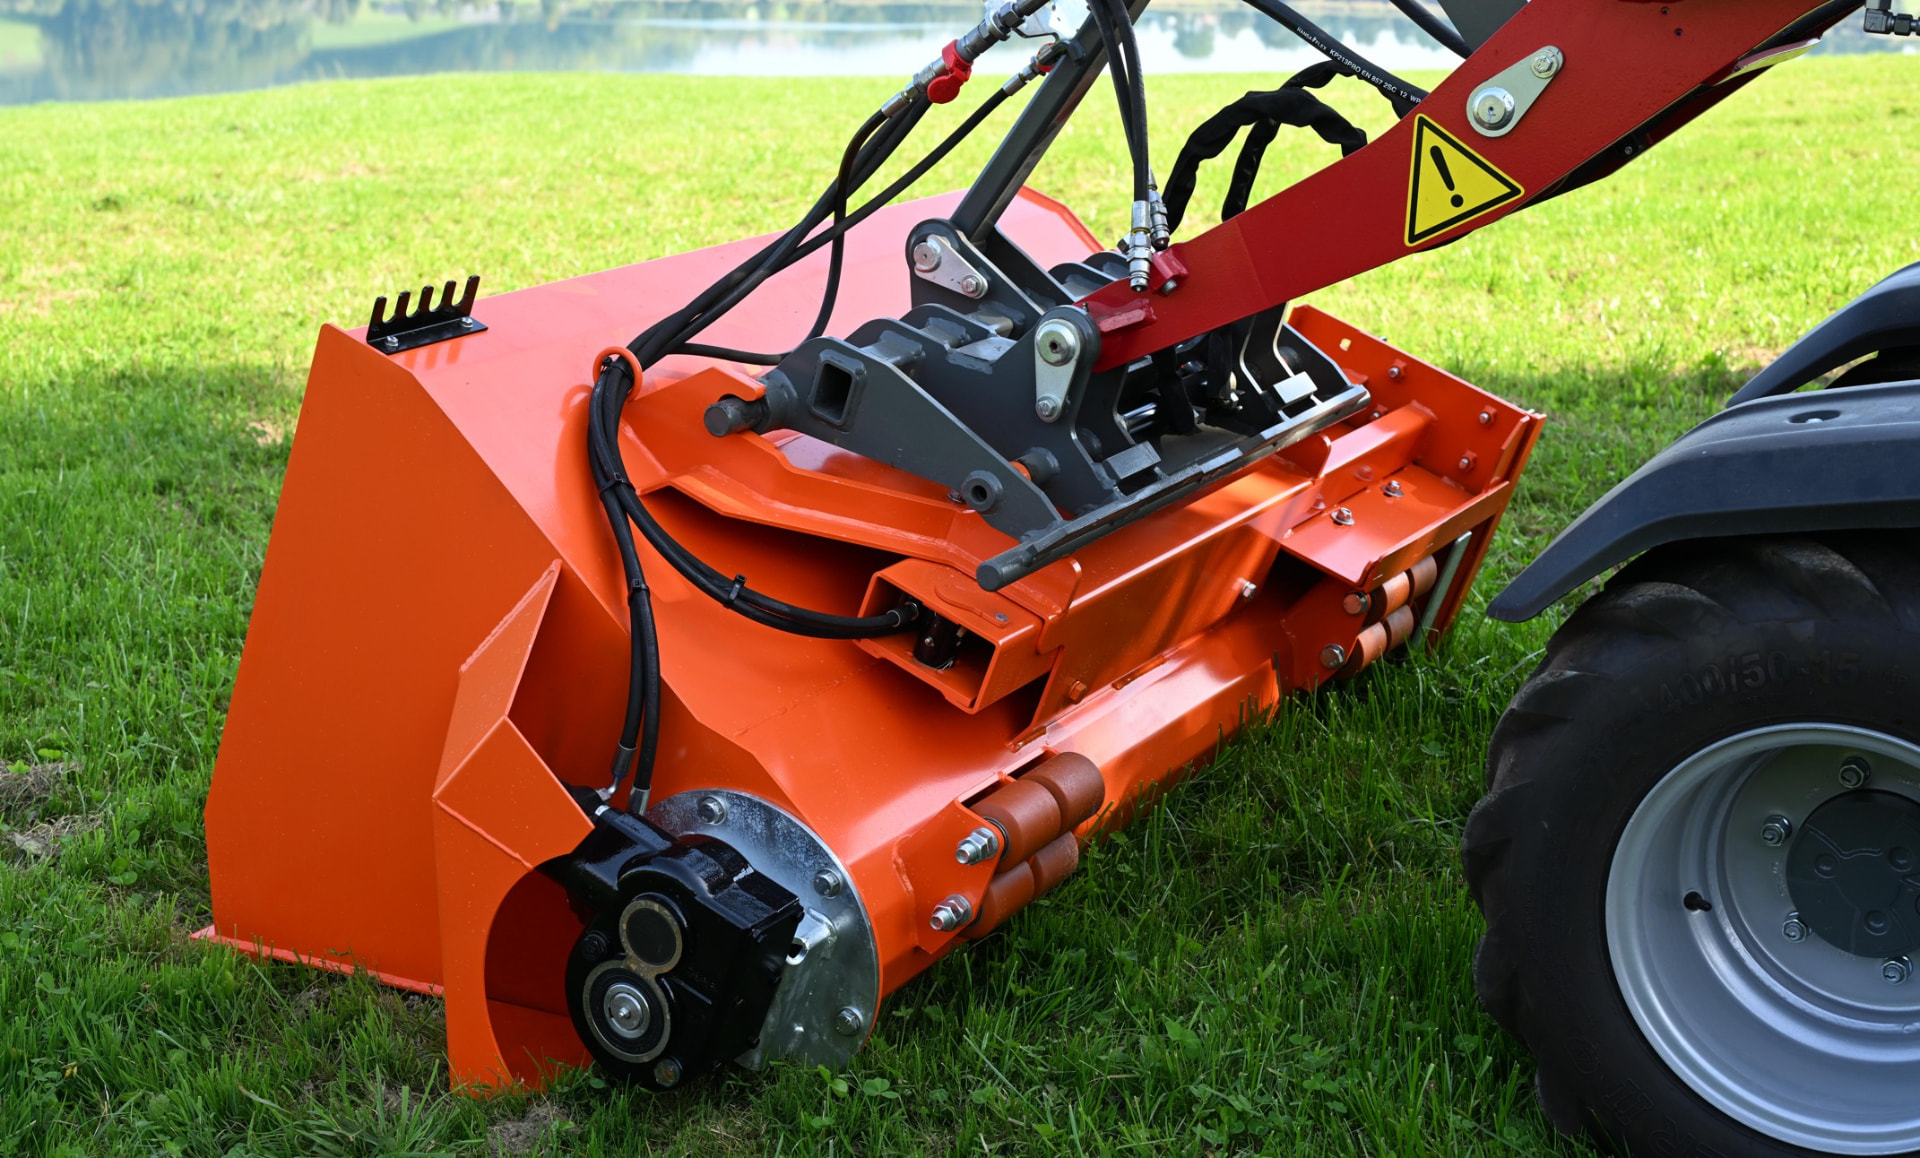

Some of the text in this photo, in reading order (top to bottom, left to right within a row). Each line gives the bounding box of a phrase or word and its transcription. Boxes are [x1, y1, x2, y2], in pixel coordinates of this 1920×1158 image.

[1329, 48, 1361, 73] KP213PRO
[1361, 69, 1372, 79] EN
[1371, 76, 1383, 87] 857
[1382, 82, 1397, 93] 2SC
[1399, 90, 1408, 99] 12
